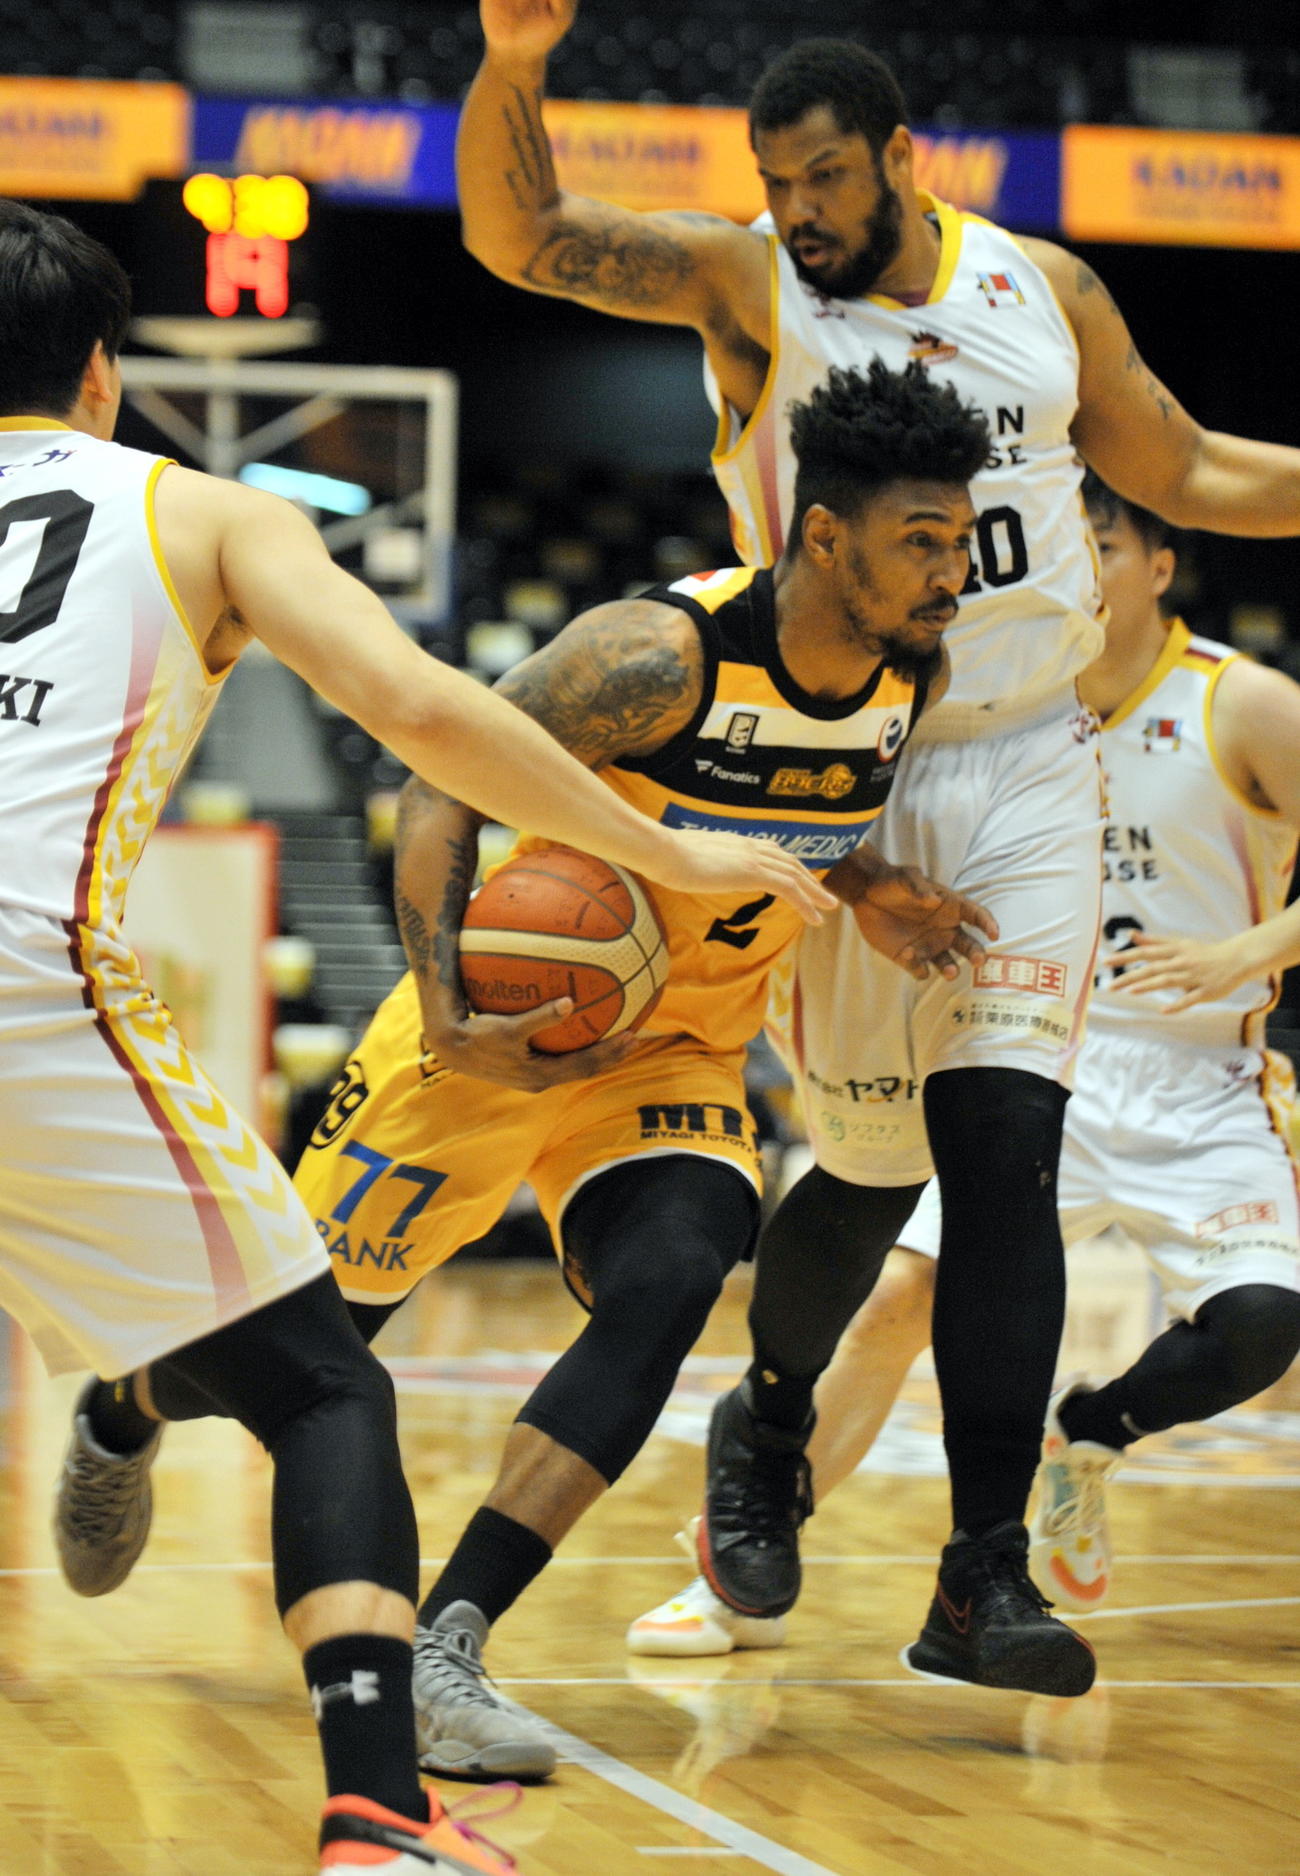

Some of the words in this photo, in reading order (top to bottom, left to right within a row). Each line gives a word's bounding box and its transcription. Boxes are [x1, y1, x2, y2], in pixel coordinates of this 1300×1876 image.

[710, 765, 761, 785] Fanatics
[466, 976, 541, 1001] molten
[330, 1138, 450, 1239] 77
